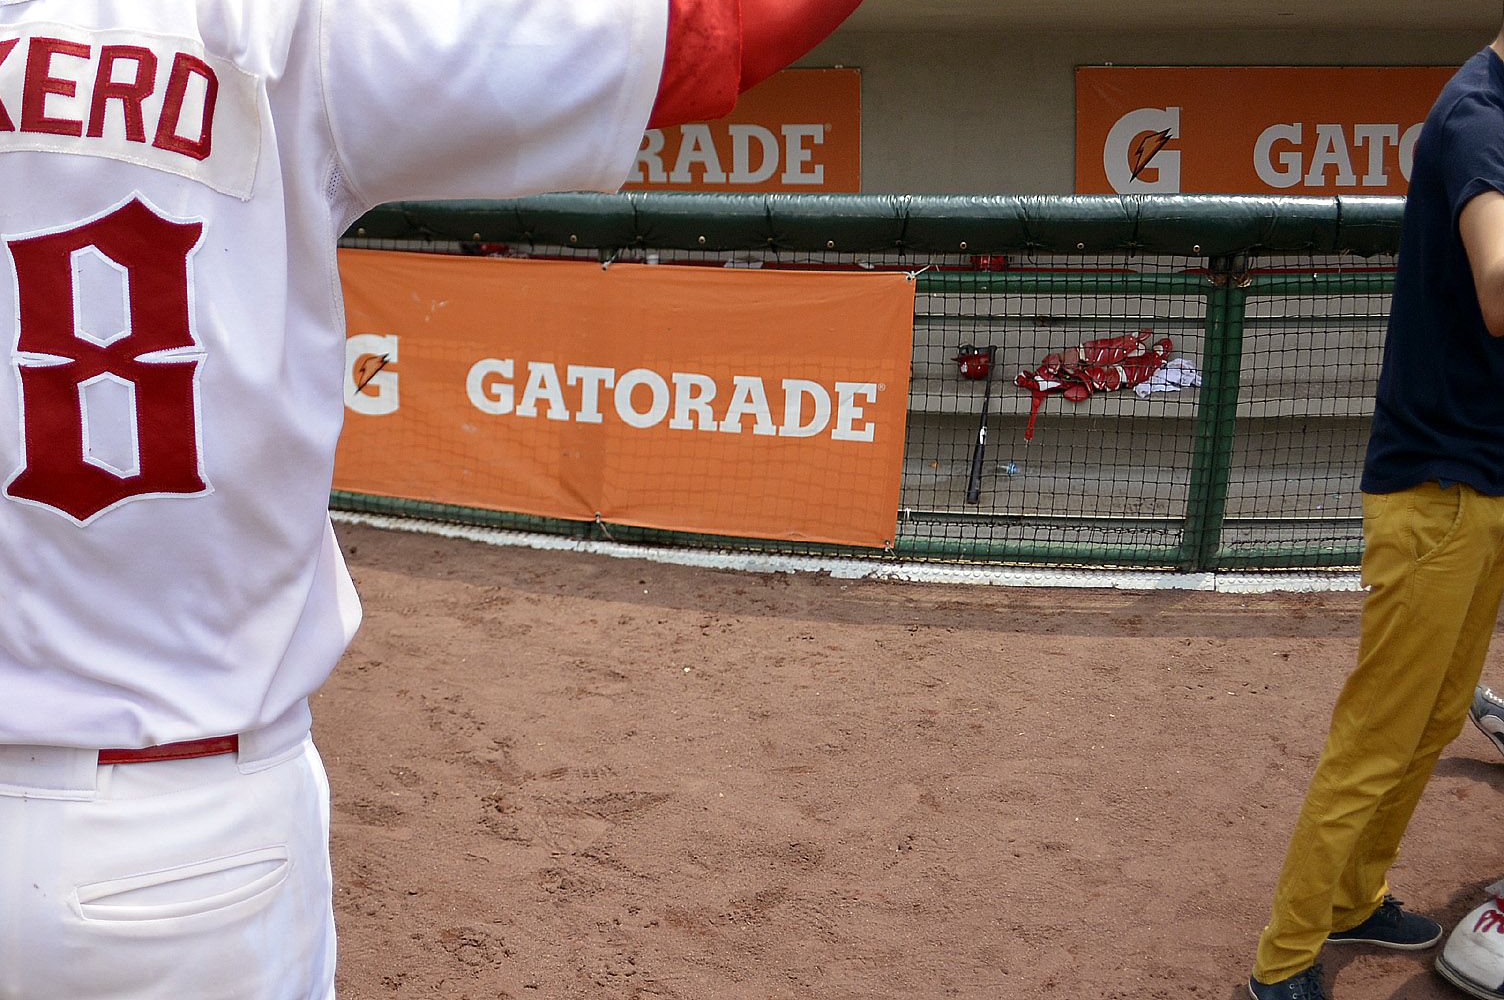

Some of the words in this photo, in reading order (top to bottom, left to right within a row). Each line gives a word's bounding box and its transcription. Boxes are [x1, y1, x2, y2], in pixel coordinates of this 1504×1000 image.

[1103, 106, 1181, 194] G
[344, 334, 400, 415] G
[466, 357, 878, 442] GATORADE
